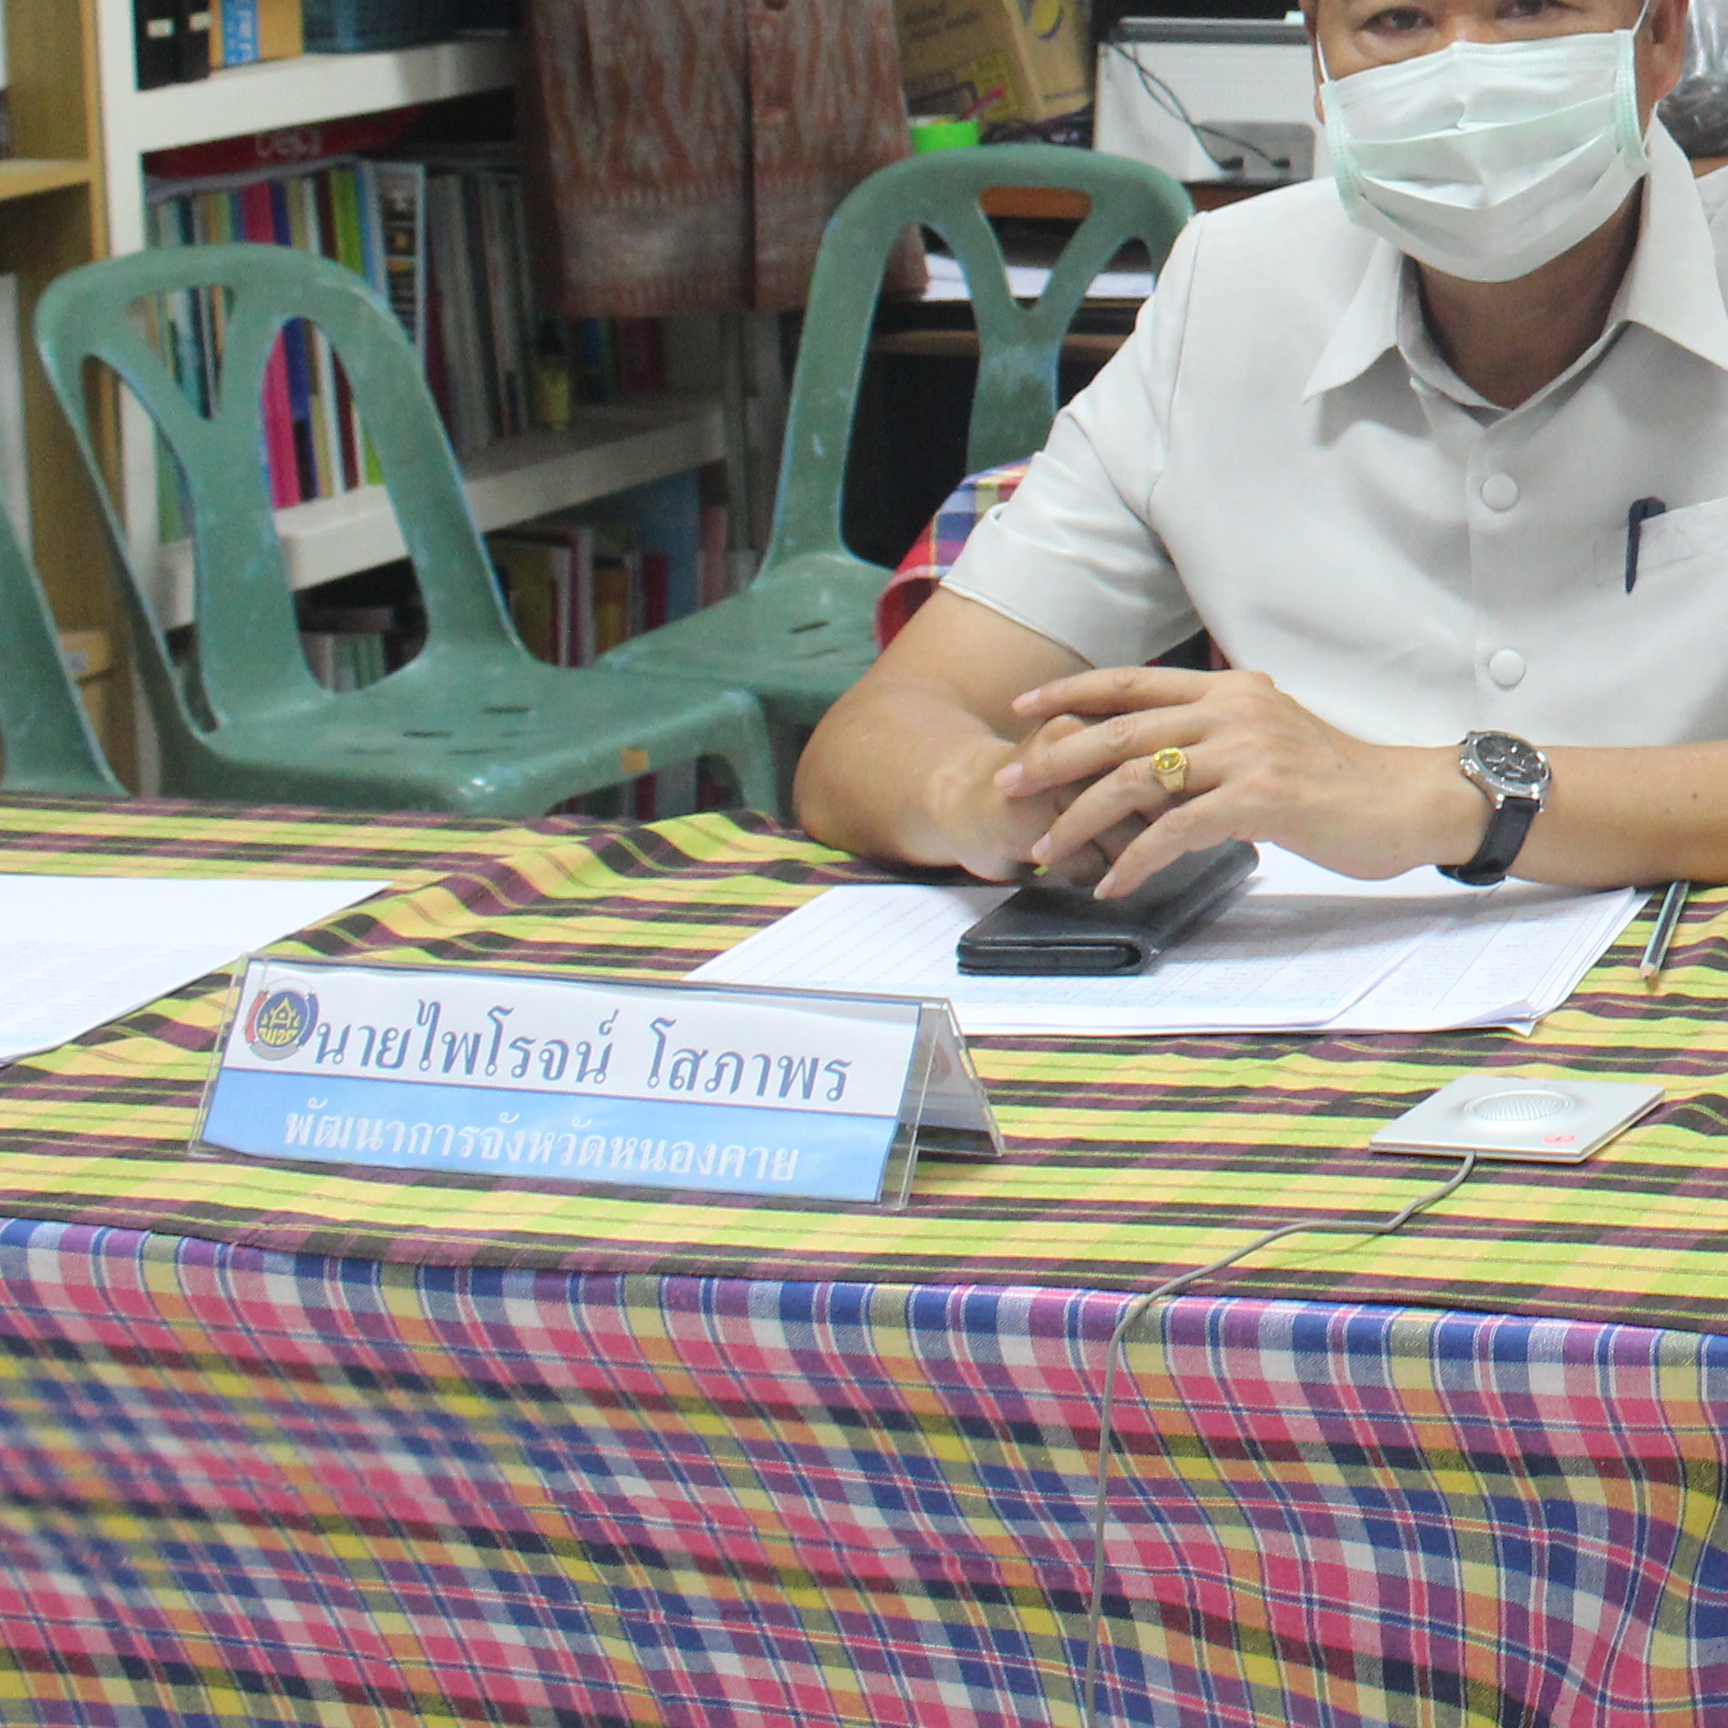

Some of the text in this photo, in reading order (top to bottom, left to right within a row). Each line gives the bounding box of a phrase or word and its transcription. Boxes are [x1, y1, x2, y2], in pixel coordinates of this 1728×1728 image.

[314, 997, 854, 1103] นายไพโรจน์ โสภาพร
[284, 1098, 800, 1183] พัฒนาการจังหวัดหนองคาย
